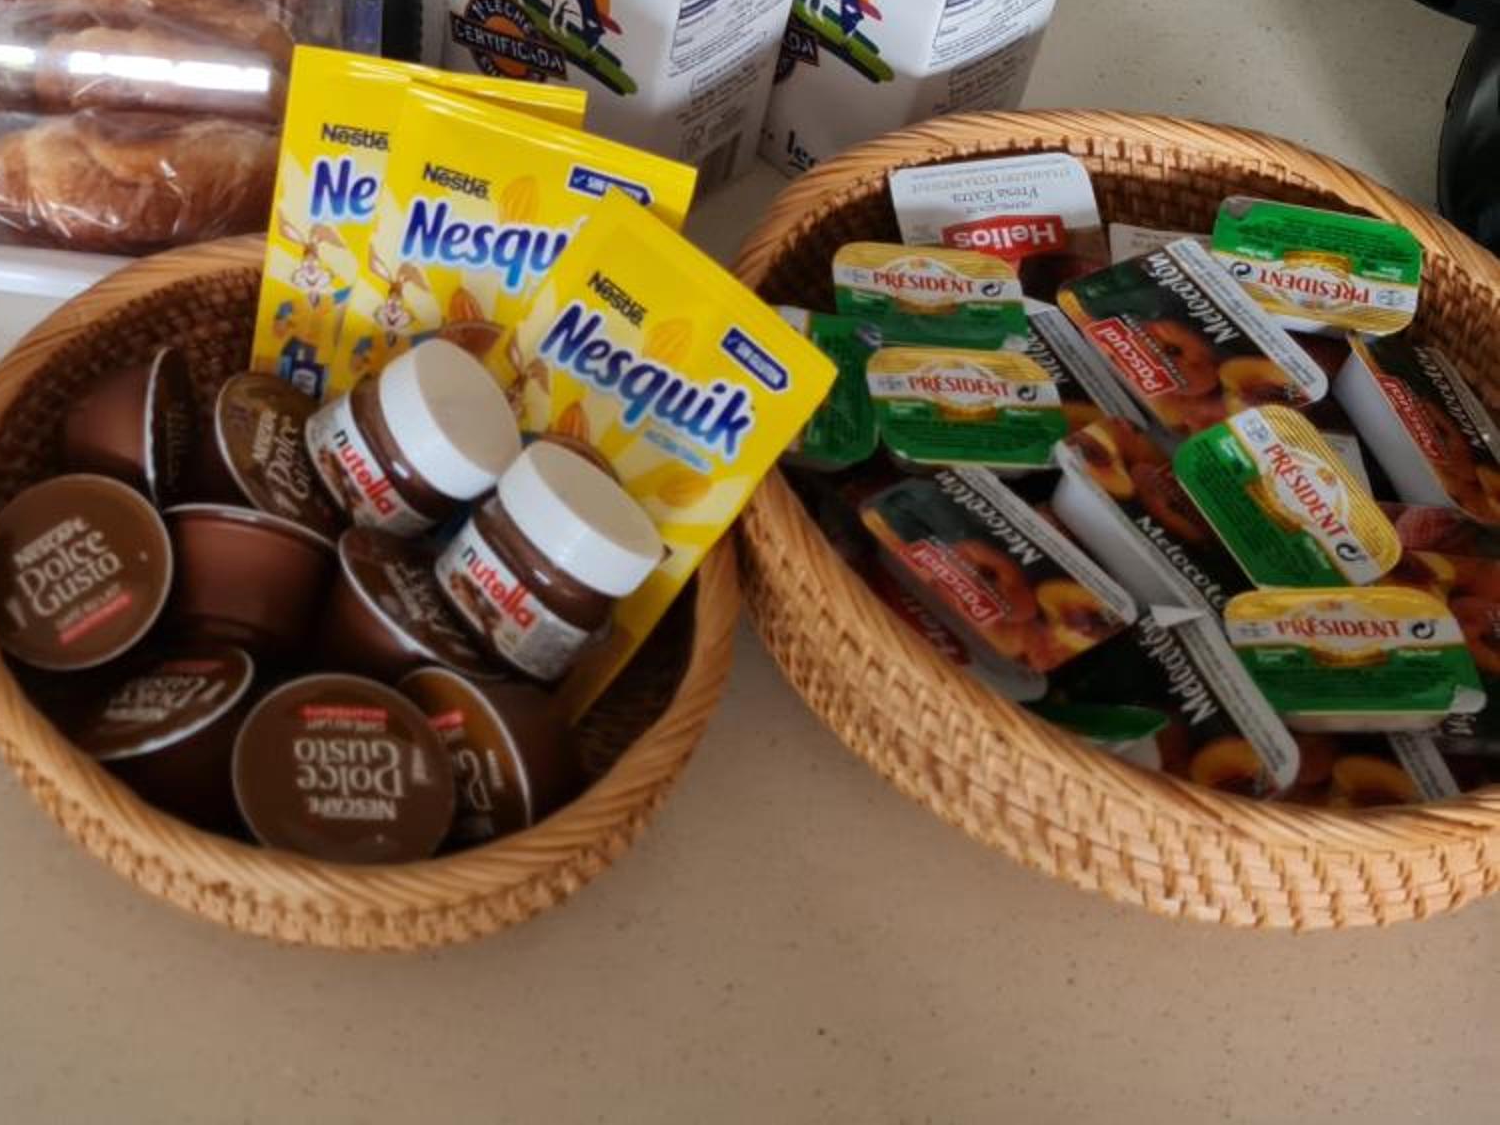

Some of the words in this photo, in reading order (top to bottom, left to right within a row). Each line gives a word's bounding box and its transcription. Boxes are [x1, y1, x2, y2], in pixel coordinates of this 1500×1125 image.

[400, 199, 568, 289] Nesqu
[953, 222, 1057, 250] Helios
[540, 303, 750, 455] Nesquik
[1098, 325, 1165, 393] Pascual
[333, 429, 397, 516] nutella
[17, 530, 108, 599] Dolce
[31, 552, 122, 617] Gusto
[462, 545, 538, 630] nutella
[912, 544, 993, 621] Pascual
[293, 737, 401, 771] Gusto
[297, 763, 405, 798] Dolce
